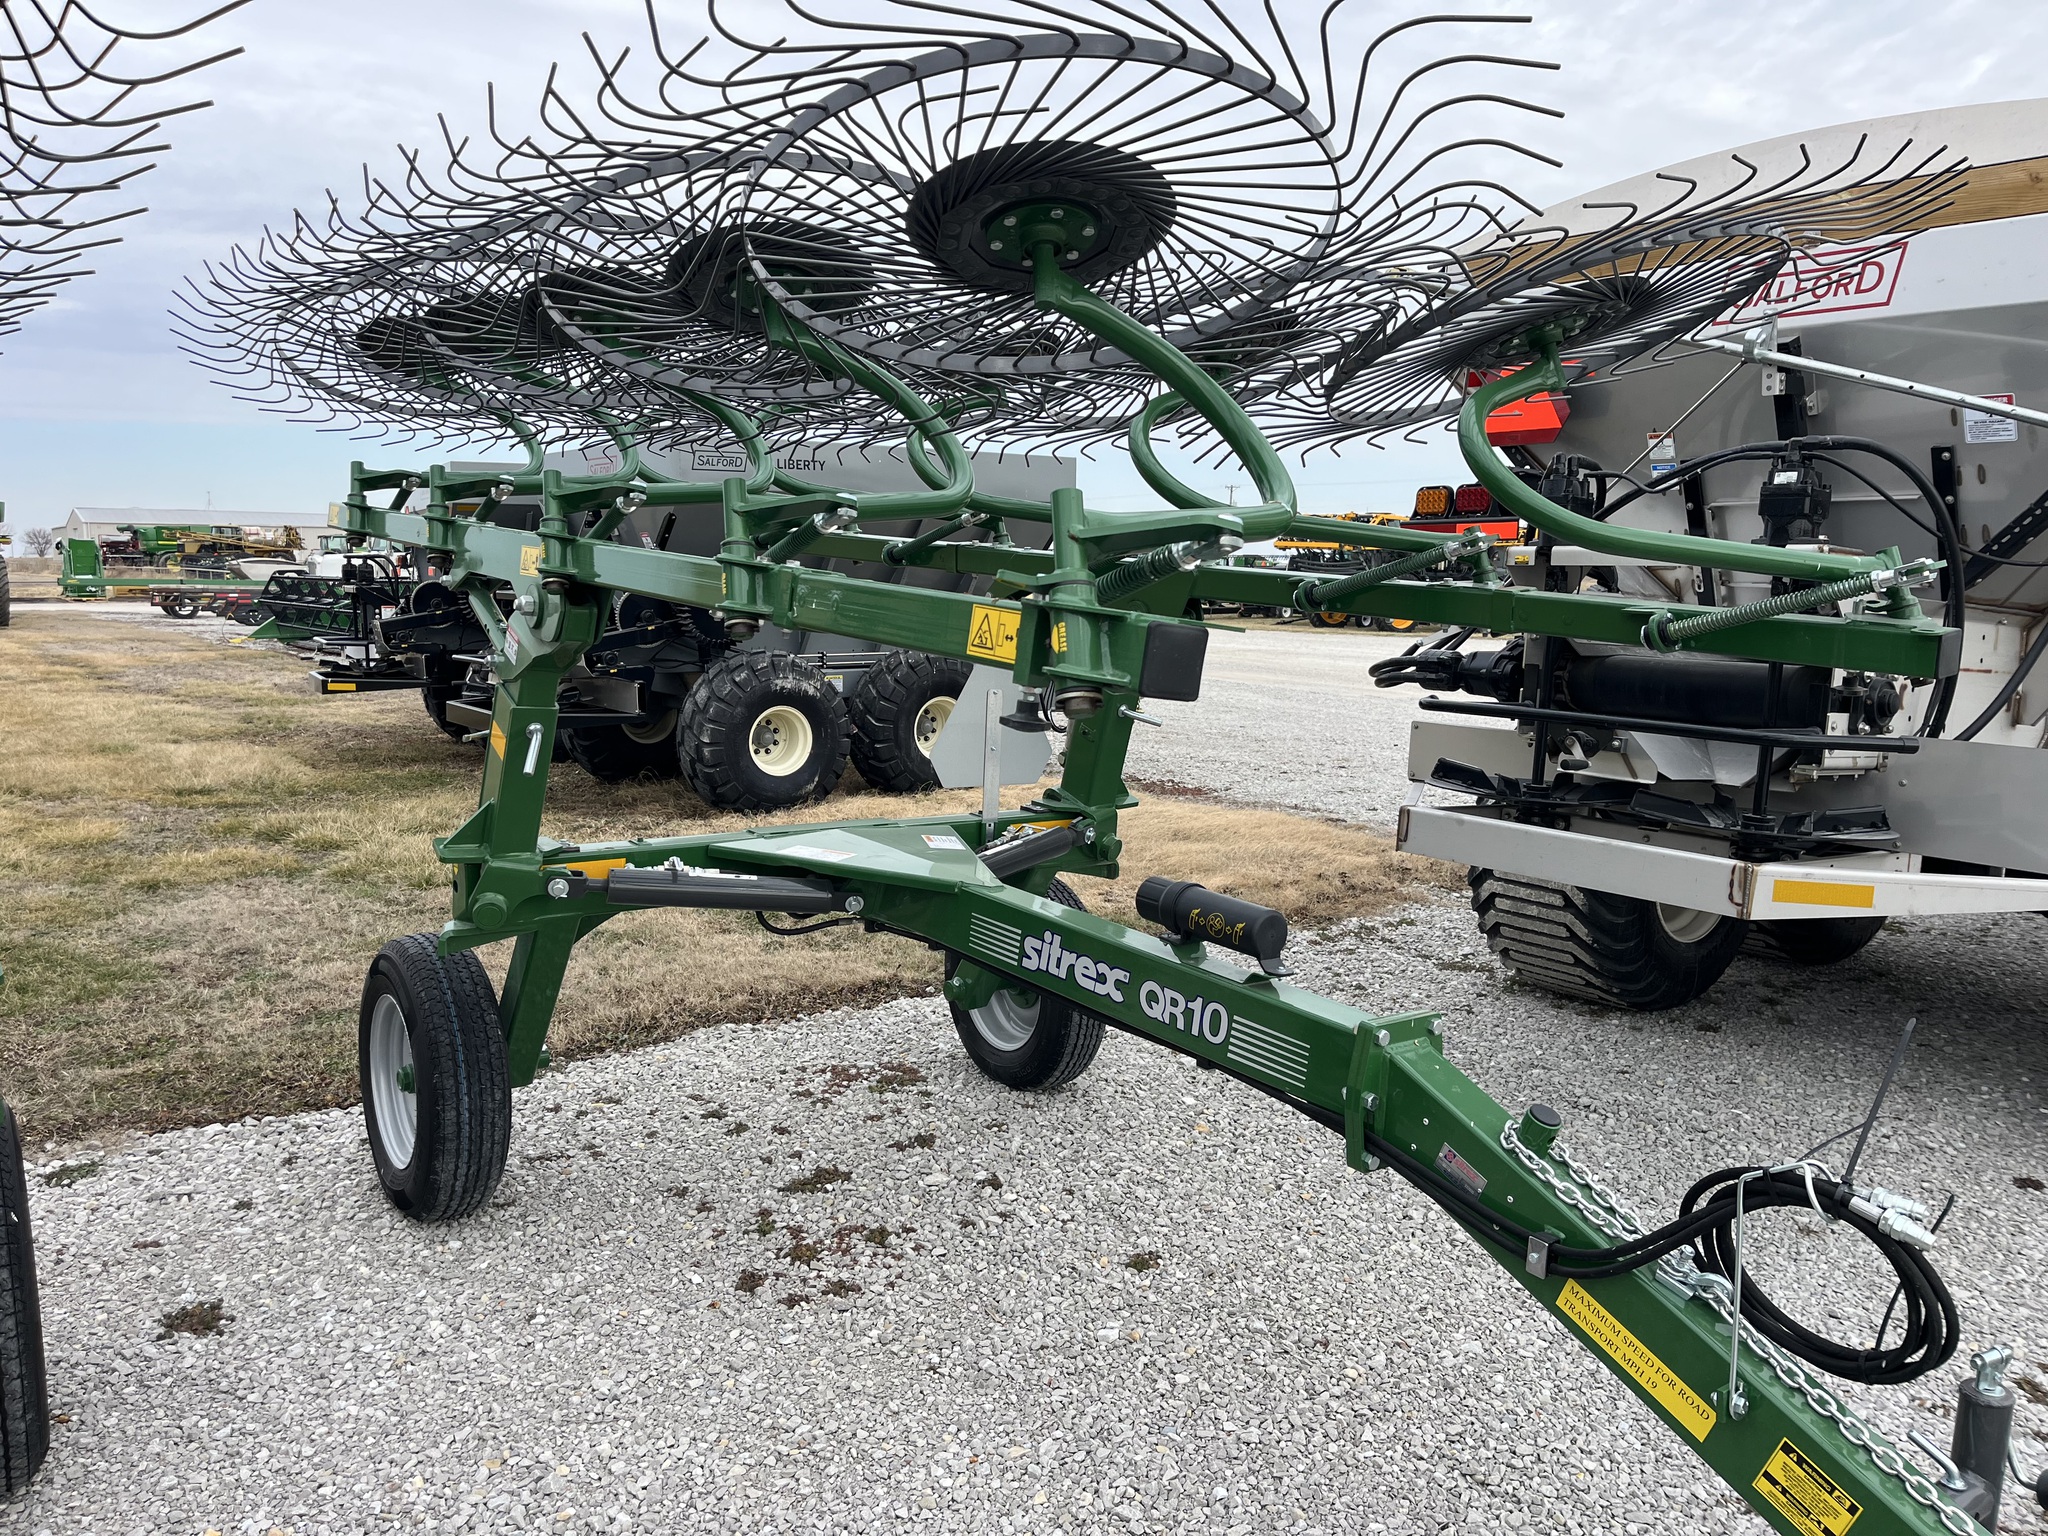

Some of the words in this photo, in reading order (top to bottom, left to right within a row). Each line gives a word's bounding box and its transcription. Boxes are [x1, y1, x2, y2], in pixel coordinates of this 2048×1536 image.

[697, 455, 743, 468] SALFORD
[777, 459, 826, 471] LIBERTY
[1058, 621, 1068, 652] GREASE
[1021, 929, 1130, 1003] sitrex
[1138, 980, 1229, 1045] QR10
[1563, 1297, 1622, 1354] TRANSPORT
[1620, 1352, 1645, 1379] MPH
[1645, 1376, 1658, 1389] 19
[1568, 1285, 1622, 1338] MAXIMUM
[1621, 1335, 1655, 1369] SPEED
[1655, 1368, 1677, 1391] FOR
[1678, 1389, 1711, 1421] ROAD
[1802, 1462, 1832, 1491] WARNING
